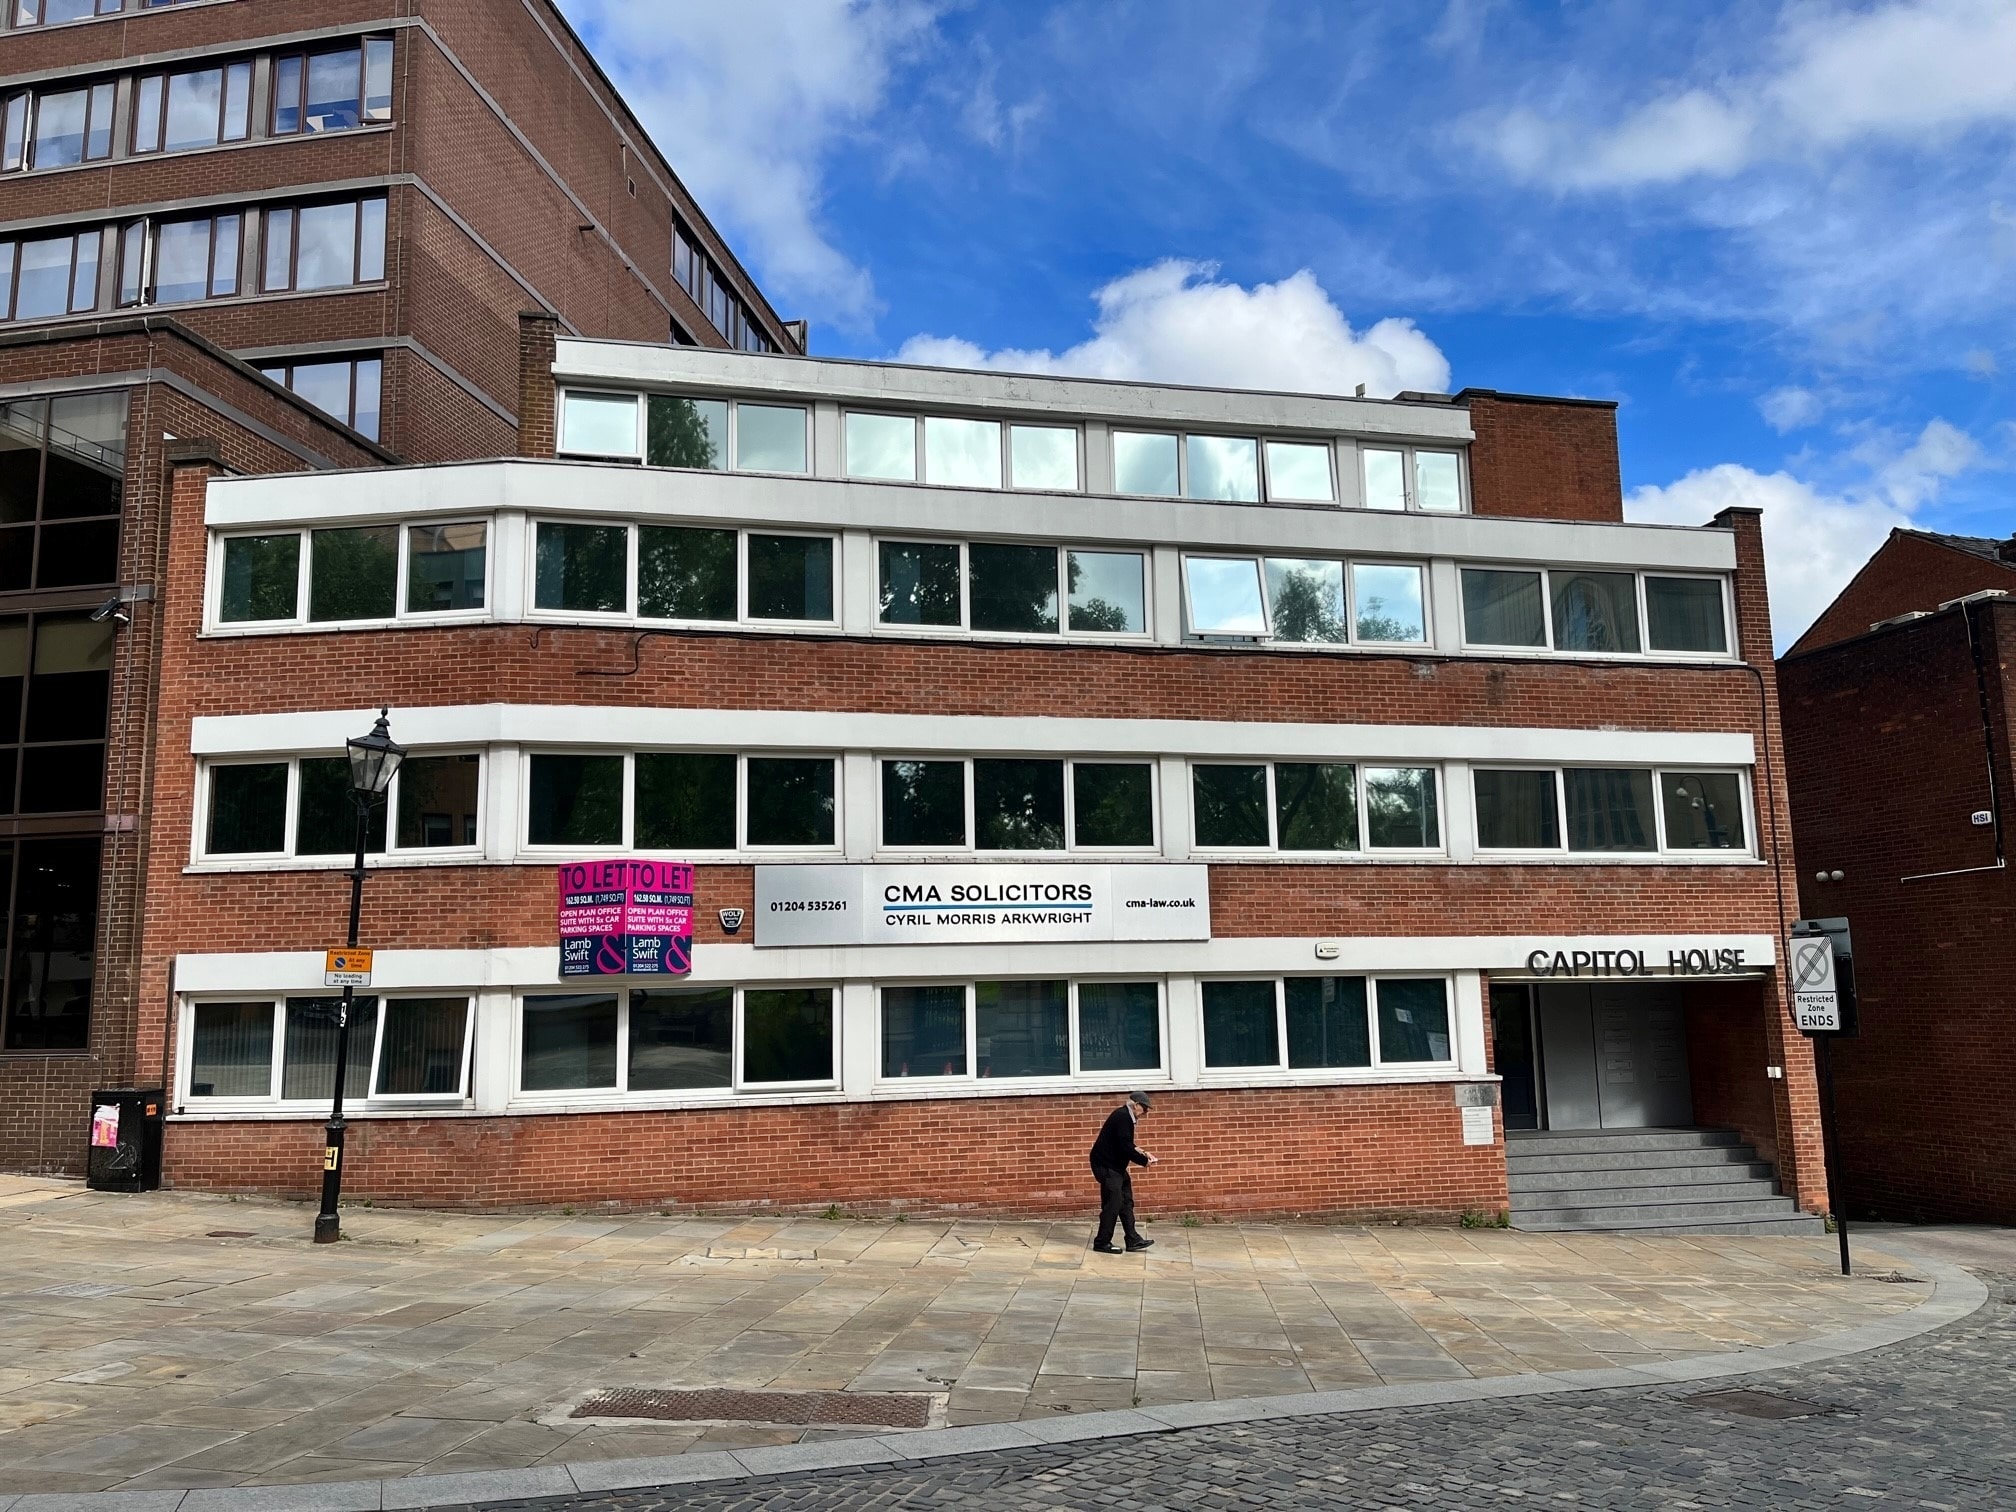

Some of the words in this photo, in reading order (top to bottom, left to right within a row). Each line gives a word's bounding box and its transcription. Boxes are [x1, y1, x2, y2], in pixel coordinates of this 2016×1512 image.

[561, 866, 586, 890] TO
[593, 864, 626, 888] LET
[629, 863, 655, 889] TO
[661, 865, 692, 890] LET
[884, 885, 942, 903] CMA
[950, 884, 1093, 902] SOLICITORS
[770, 901, 805, 912] 01204
[807, 900, 847, 911] 535261
[1125, 897, 1196, 909] cma-law.co.uk
[560, 910, 578, 918] OPEN
[578, 909, 597, 917] PLAN
[597, 907, 622, 916] OFFICE
[627, 907, 646, 915] OPEN
[647, 908, 665, 916] PLAN
[666, 909, 688, 917] OFFICE
[560, 918, 577, 926] SUITE
[577, 917, 595, 925] WITH
[605, 915, 620, 923] CAR
[647, 916, 664, 924] WITH
[673, 917, 687, 925] CAR
[885, 914, 931, 926] CYRIL
[936, 913, 996, 925] MORRIS
[1001, 912, 1092, 924] ARKWRIGHT
[560, 926, 587, 934] PARKING
[588, 924, 613, 932] SPACES
[627, 924, 657, 932] PARKING
[657, 925, 681, 933] SPACES
[564, 937, 592, 950] Lamb
[632, 936, 661, 948] Lamb
[564, 949, 590, 961] Swift
[632, 947, 659, 960] Swift
[1527, 949, 1653, 977] CAPITOL
[1668, 948, 1745, 976] HOUSE
[1797, 995, 1834, 1003] Restricted
[1807, 1003, 1825, 1011] Zone
[1801, 1015, 1834, 1026] ENDS
